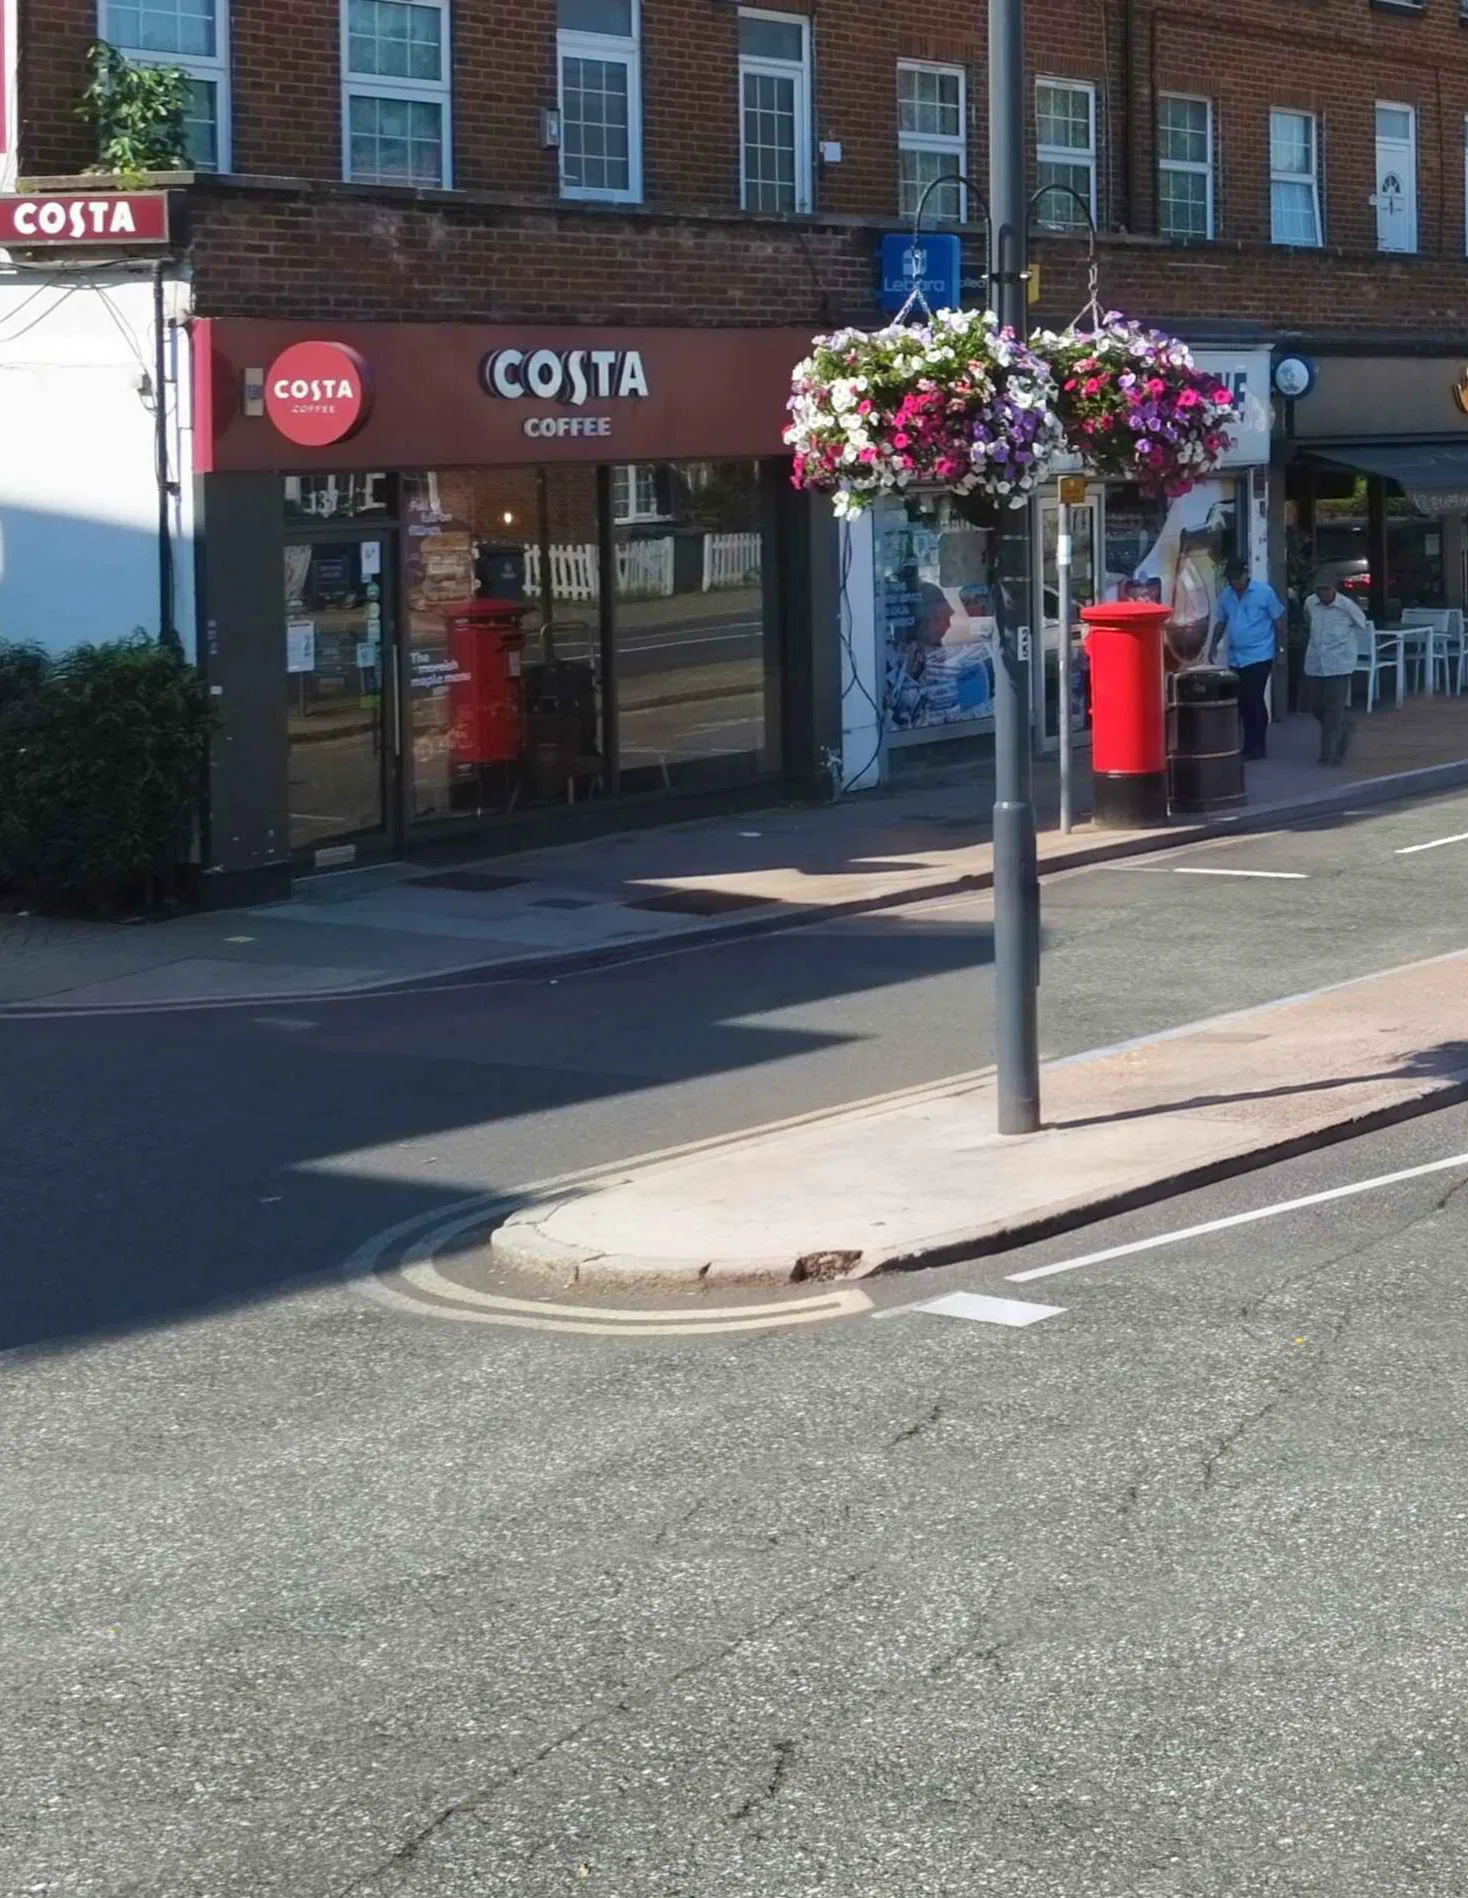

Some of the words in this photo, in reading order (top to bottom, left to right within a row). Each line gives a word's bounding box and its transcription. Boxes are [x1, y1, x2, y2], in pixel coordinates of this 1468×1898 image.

[14, 201, 136, 238] COSTA
[492, 349, 649, 405] COSTA
[274, 379, 354, 402] COSTA
[291, 404, 335, 414] COFFEE
[524, 416, 612, 437] COFFEE
